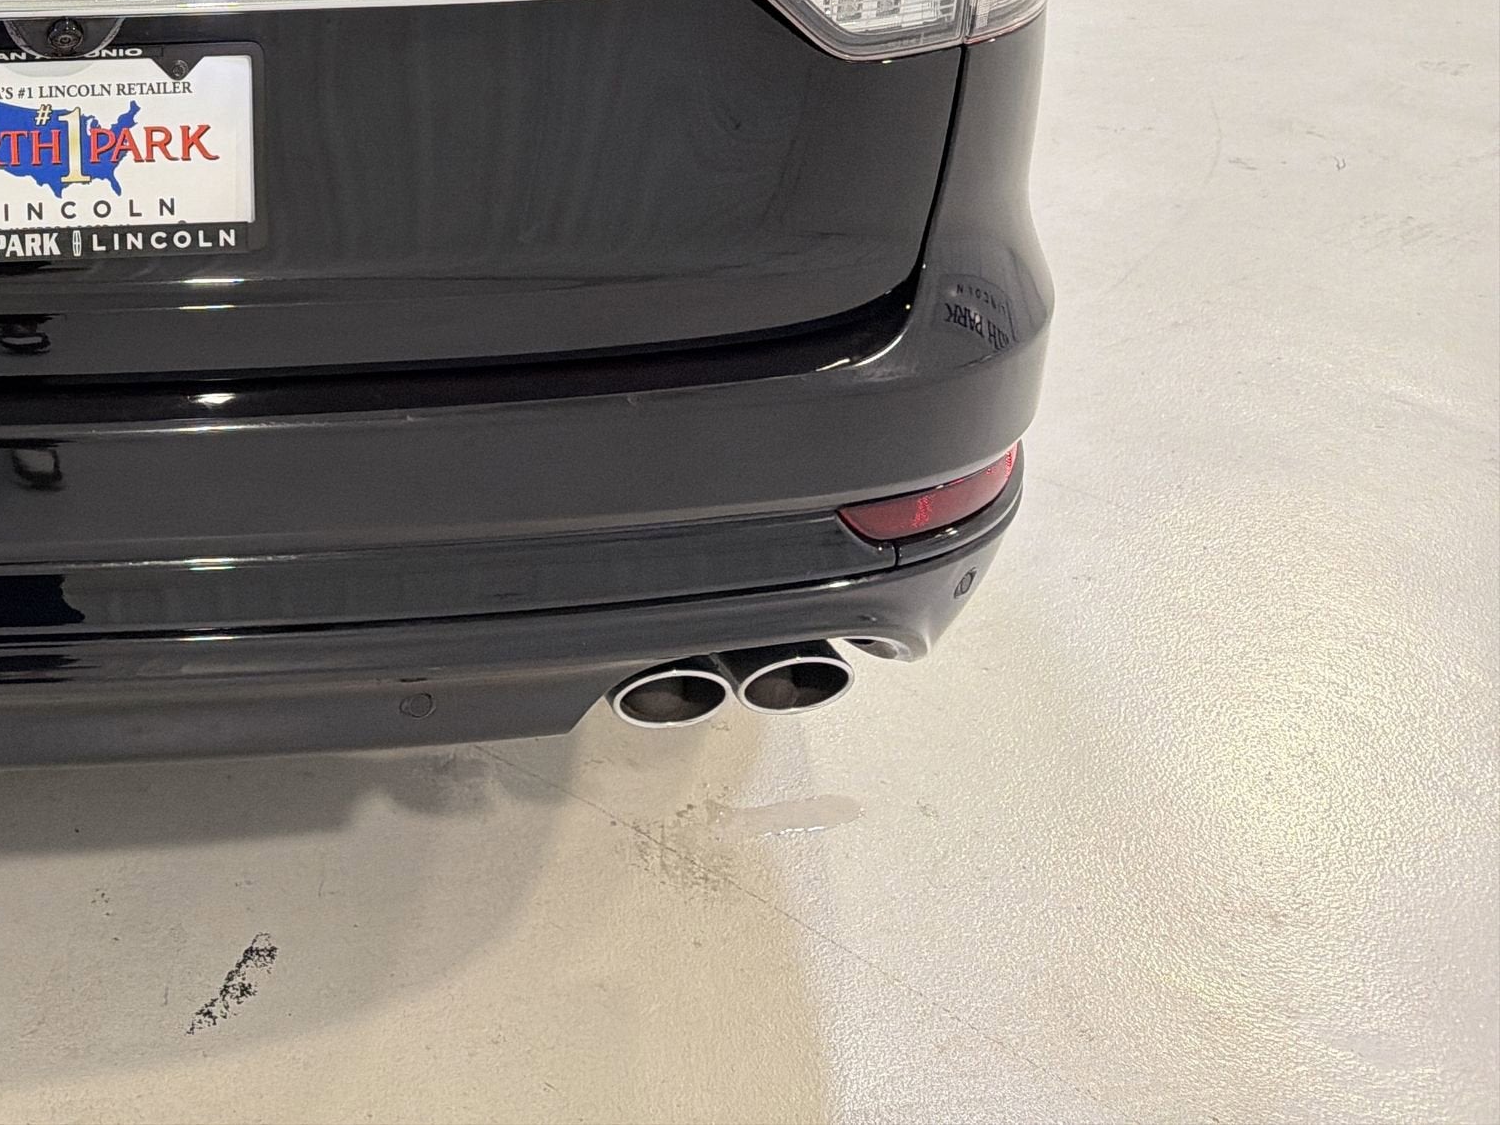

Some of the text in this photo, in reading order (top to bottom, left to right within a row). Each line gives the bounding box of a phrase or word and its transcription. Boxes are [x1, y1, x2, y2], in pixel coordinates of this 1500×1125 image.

[18, 86, 33, 100] #1
[38, 83, 112, 99] LINCOLN
[116, 81, 193, 97] RETAILER
[89, 124, 220, 164] PARK
[92, 229, 236, 252] LINCOLN
